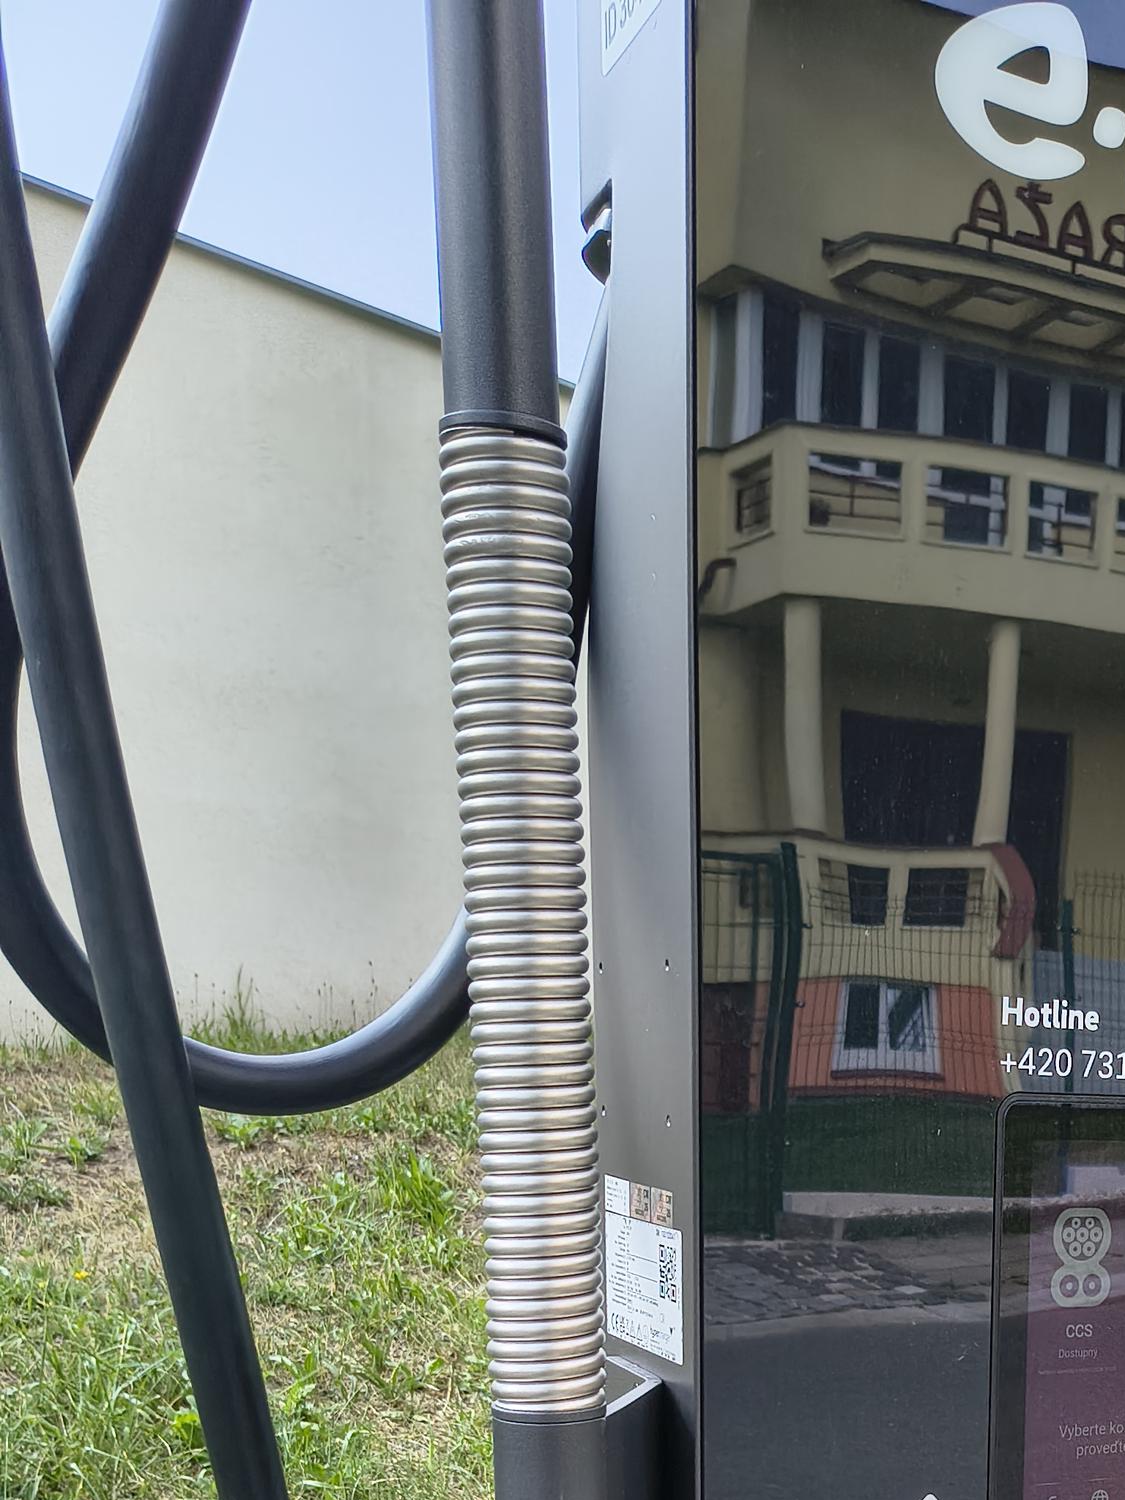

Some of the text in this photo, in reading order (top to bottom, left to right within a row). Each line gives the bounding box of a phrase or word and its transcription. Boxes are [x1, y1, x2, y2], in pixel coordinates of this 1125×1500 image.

[1001, 996, 1100, 1031] Hotline
[1000, 1047, 1073, 1077] +420
[1065, 1323, 1093, 1338] CCS
[1058, 1422, 1106, 1441] Vyberte
